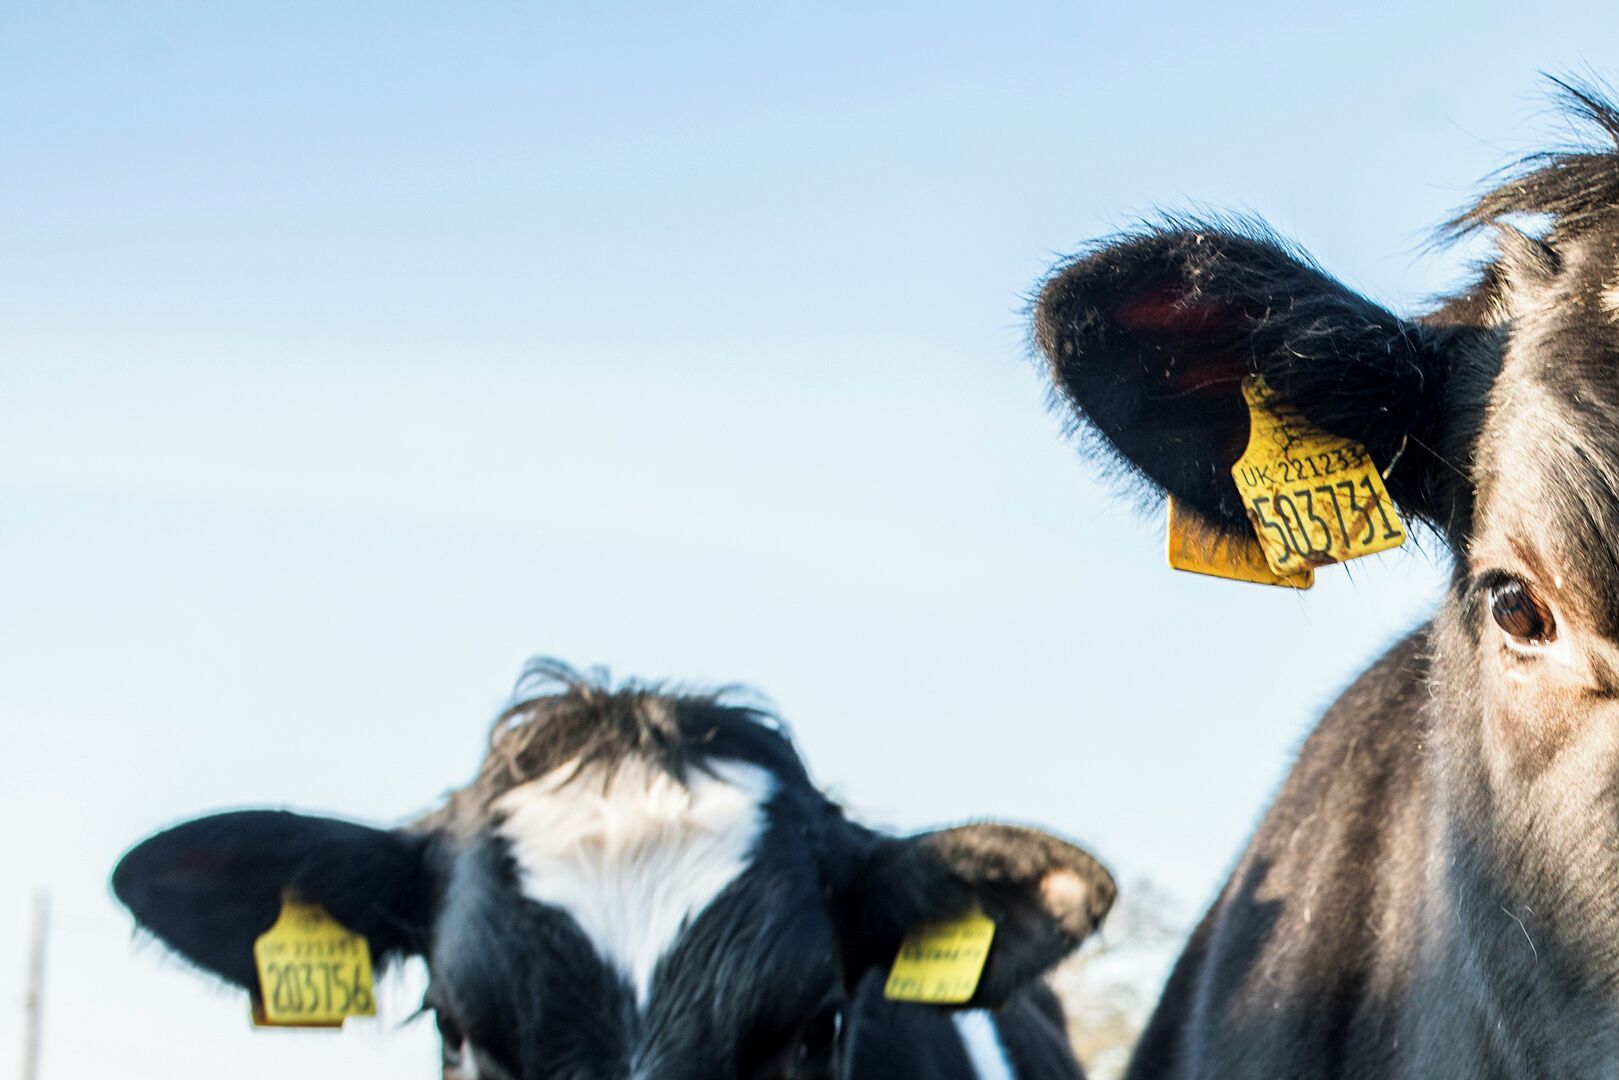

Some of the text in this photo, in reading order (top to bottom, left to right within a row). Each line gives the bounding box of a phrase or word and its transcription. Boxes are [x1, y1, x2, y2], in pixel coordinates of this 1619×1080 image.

[1240, 447, 1363, 488] UK 221233
[1252, 474, 1402, 565] 503731
